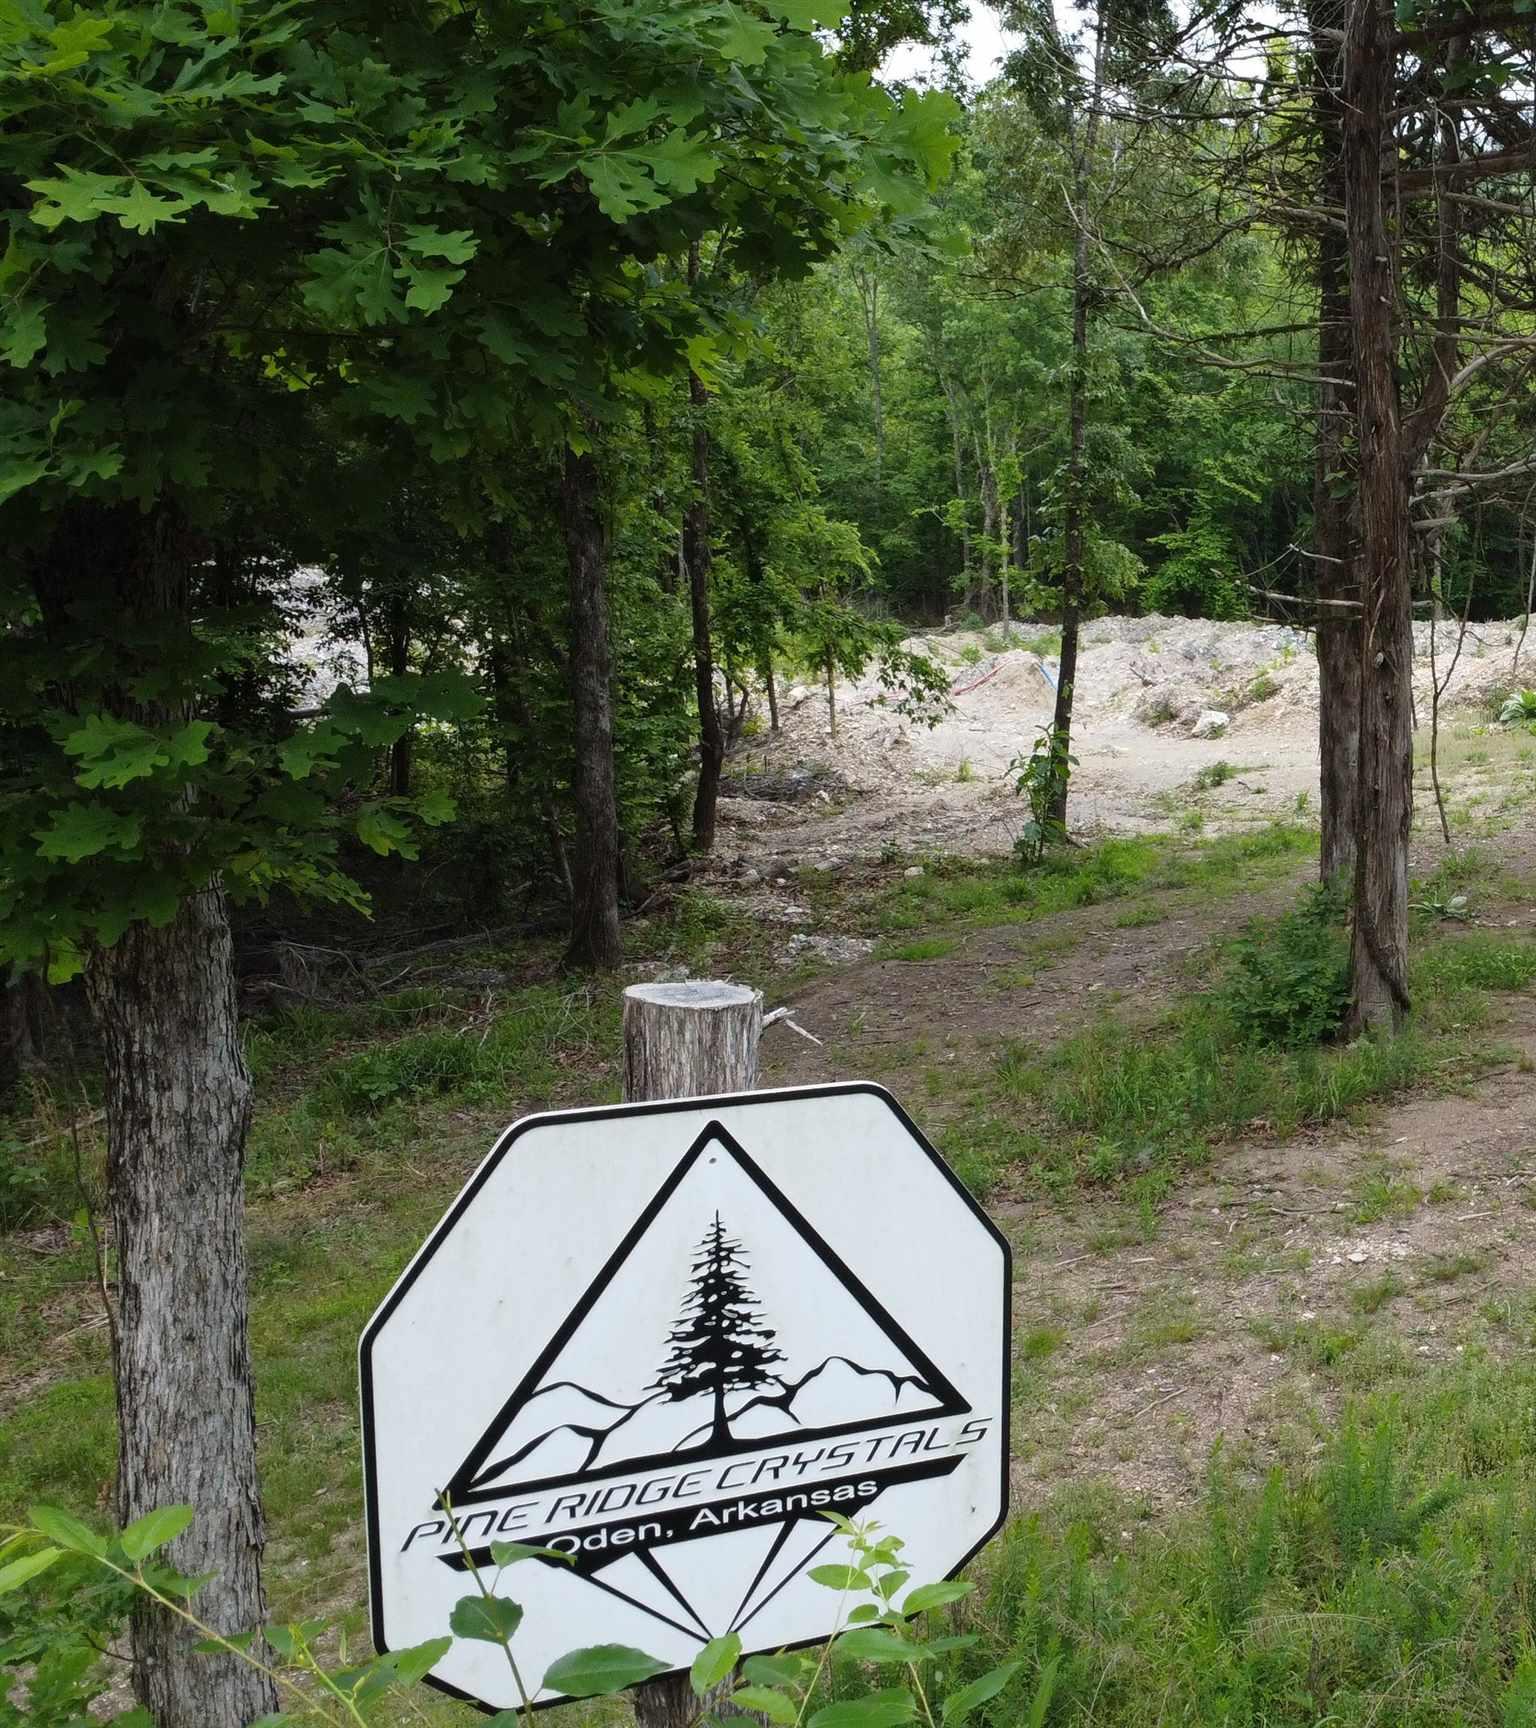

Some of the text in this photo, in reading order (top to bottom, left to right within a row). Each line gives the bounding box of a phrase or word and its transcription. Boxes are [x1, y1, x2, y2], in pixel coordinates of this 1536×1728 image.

[400, 1417, 993, 1552] PINE RIDGE CRYSTALS
[545, 1480, 878, 1556] Oden, Arkansas
